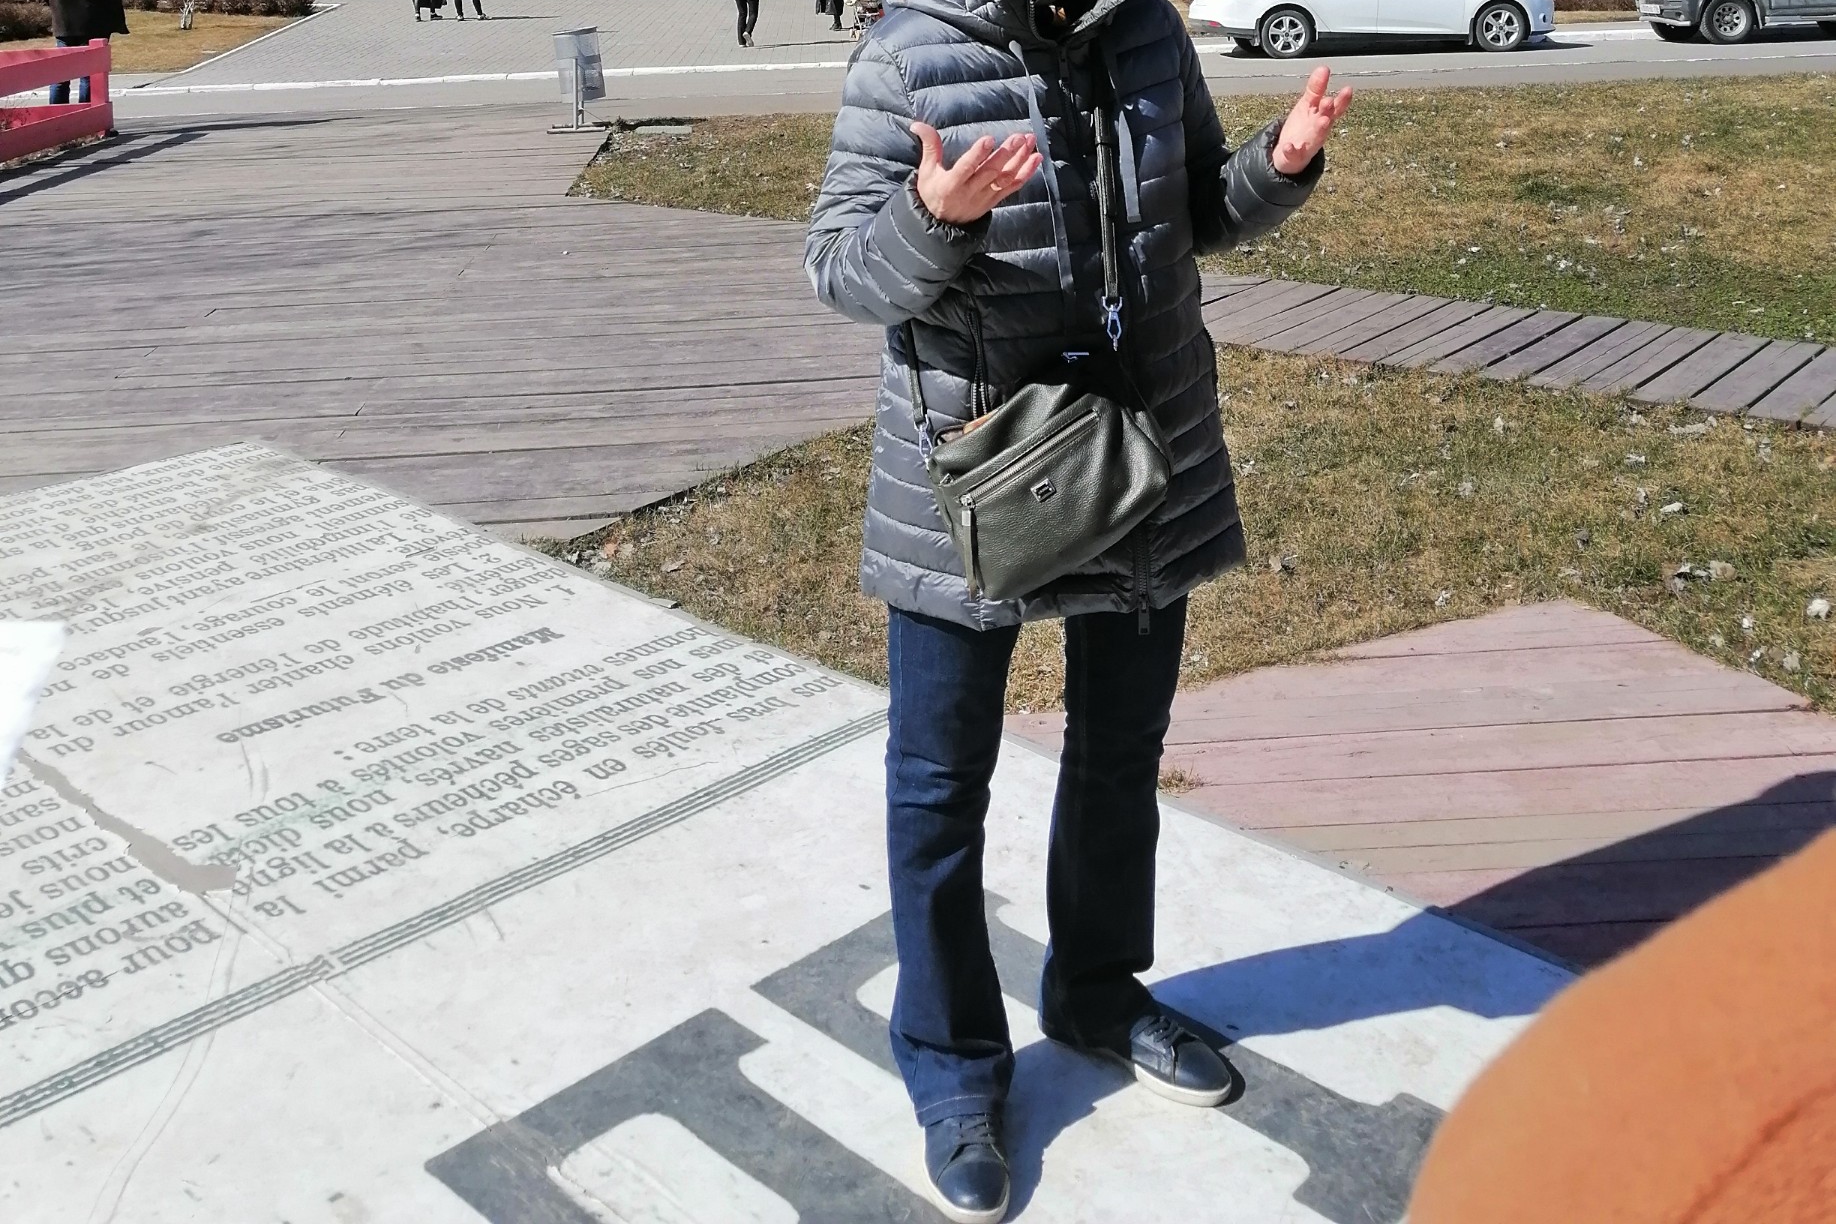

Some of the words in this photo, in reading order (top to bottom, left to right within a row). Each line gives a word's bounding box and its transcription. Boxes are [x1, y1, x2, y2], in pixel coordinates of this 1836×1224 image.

[128, 455, 219, 477] tuyaux,
[175, 468, 209, 478] de
[205, 450, 281, 471] mobile
[240, 464, 313, 484] monde
[37, 493, 95, 510] avec
[43, 486, 89, 498] des
[121, 480, 203, 503] beauté
[182, 481, 237, 500] s'est
[223, 482, 287, 499] Nous
[247, 496, 278, 506] le
[274, 489, 302, 500] et
[328, 480, 370, 497] pas
[56, 506, 88, 517] la
[78, 495, 178, 524] enrichie
[86, 499, 122, 510] de
[108, 496, 228, 529] déclarons
[184, 503, 248, 522] coup
[302, 498, 410, 532] sommeil,
[304, 490, 389, 519] vement
[59, 523, 109, 542] que
[67, 525, 149, 551] poing.
[151, 519, 189, 531] de
[198, 514, 306, 545] agressif,
[363, 531, 407, 546] La
[404, 522, 437, 534] 3.
[27, 538, 59, 550] la
[128, 540, 160, 551] le
[237, 530, 301, 551] nous
[246, 519, 397, 566] l'immobilité
[419, 533, 496, 563] poésie
[66, 541, 207, 584] l'insomnie
[132, 547, 237, 581] voulons
[242, 541, 373, 581] littérature
[336, 559, 420, 589] seront
[418, 561, 474, 580] Les
[433, 556, 547, 593] témérité.
[123, 560, 238, 596] pensive,
[164, 575, 246, 605] ayant
[303, 584, 340, 598] le
[470, 566, 573, 597] danger,
[542, 583, 579, 596] 1.
[25, 578, 126, 610] exalter
[294, 578, 418, 618] éléments
[472, 593, 549, 620] Nous
[177, 595, 299, 632] courage,
[345, 595, 483, 641] l'habitude
[53, 630, 184, 672] l'audace
[148, 615, 287, 663] essentiels
[300, 637, 347, 655] de
[360, 617, 471, 656] voulons
[424, 625, 566, 676] Manifeste
[599, 624, 720, 668] hommes
[685, 636, 746, 660] mes
[89, 662, 136, 681] de
[629, 657, 688, 681] nos
[739, 648, 778, 666] et
[166, 651, 302, 698] l'énergie
[240, 652, 357, 695] chanter
[378, 671, 433, 692] du
[504, 661, 608, 701] vivants
[688, 660, 751, 684] des
[785, 674, 844, 698] nos
[119, 694, 157, 714] et
[486, 673, 632, 734] premières
[661, 660, 810, 720] complainte
[69, 707, 119, 728] de
[107, 691, 240, 738] l'amour
[213, 686, 388, 746] Futurisme
[428, 709, 474, 727] la
[463, 696, 514, 716] de
[524, 679, 692, 744] naturalistes
[722, 694, 800, 724] bras
[24, 723, 69, 742] la
[614, 712, 680, 737] des
[45, 735, 101, 758] du
[534, 729, 625, 768] sages
[629, 719, 735, 761] foulés
[348, 727, 487, 783] volontés
[398, 740, 525, 788] navrés,
[580, 756, 632, 781] en
[315, 778, 353, 800] à
[390, 757, 541, 829] pêcheurs
[232, 790, 317, 827] tous
[306, 788, 397, 830] nous
[430, 777, 587, 839] écharpe,
[169, 822, 232, 852] les
[321, 833, 372, 857] la
[361, 820, 403, 845] à
[18, 834, 110, 877] crits
[310, 834, 429, 901] parmi
[37, 854, 135, 901] nous
[223, 850, 329, 899] ligne
[114, 876, 163, 907] et
[17, 888, 113, 942] plus
[250, 892, 307, 921] la
[42, 899, 190, 967] aurons
[115, 915, 222, 975] pour
